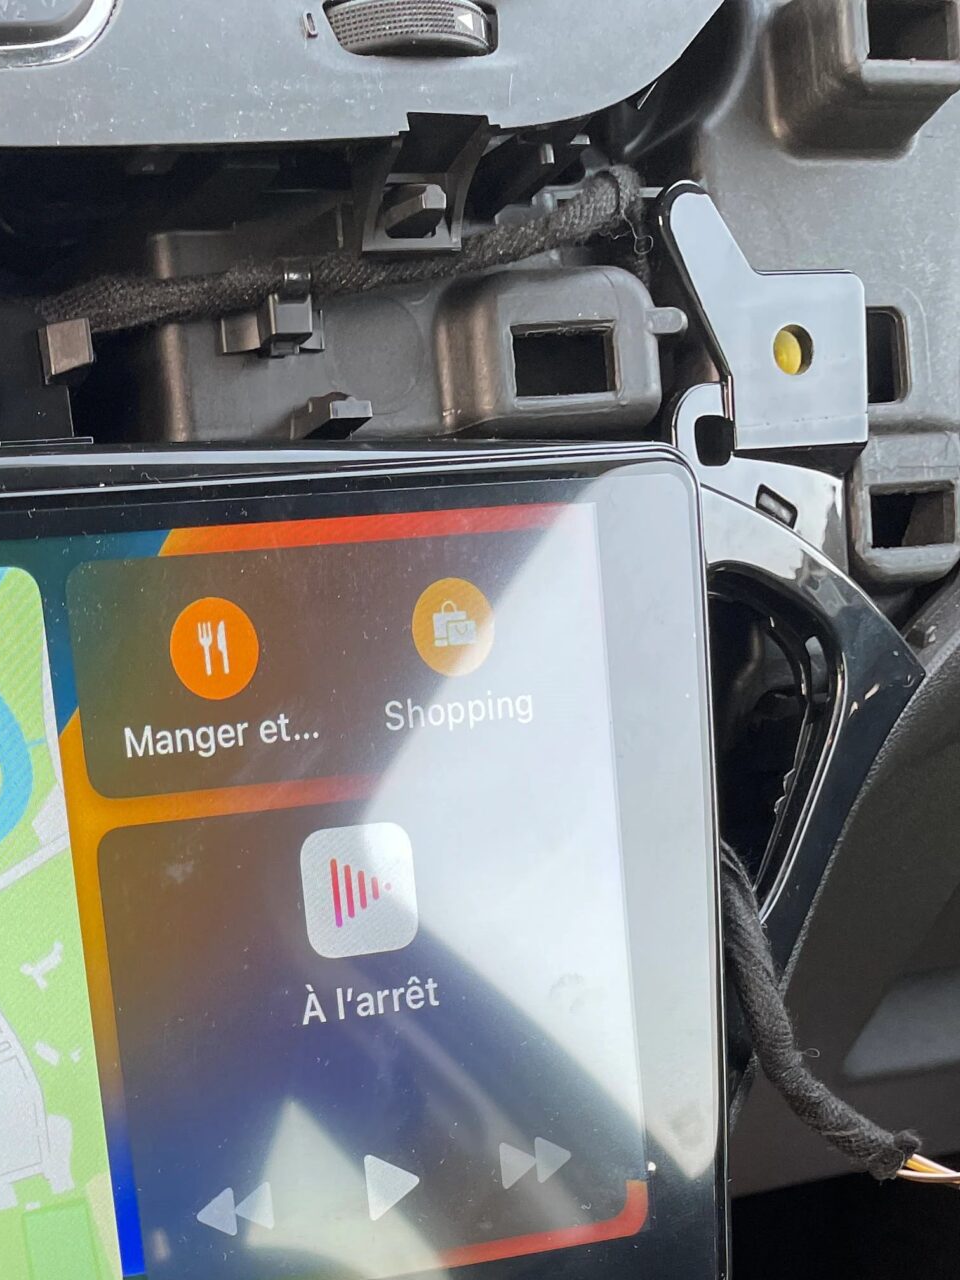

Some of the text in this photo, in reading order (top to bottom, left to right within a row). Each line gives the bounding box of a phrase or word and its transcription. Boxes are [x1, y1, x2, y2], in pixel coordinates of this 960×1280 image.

[384, 690, 533, 731] Shopping
[123, 719, 248, 758] Manger
[301, 975, 440, 1025] À l'arrêt
